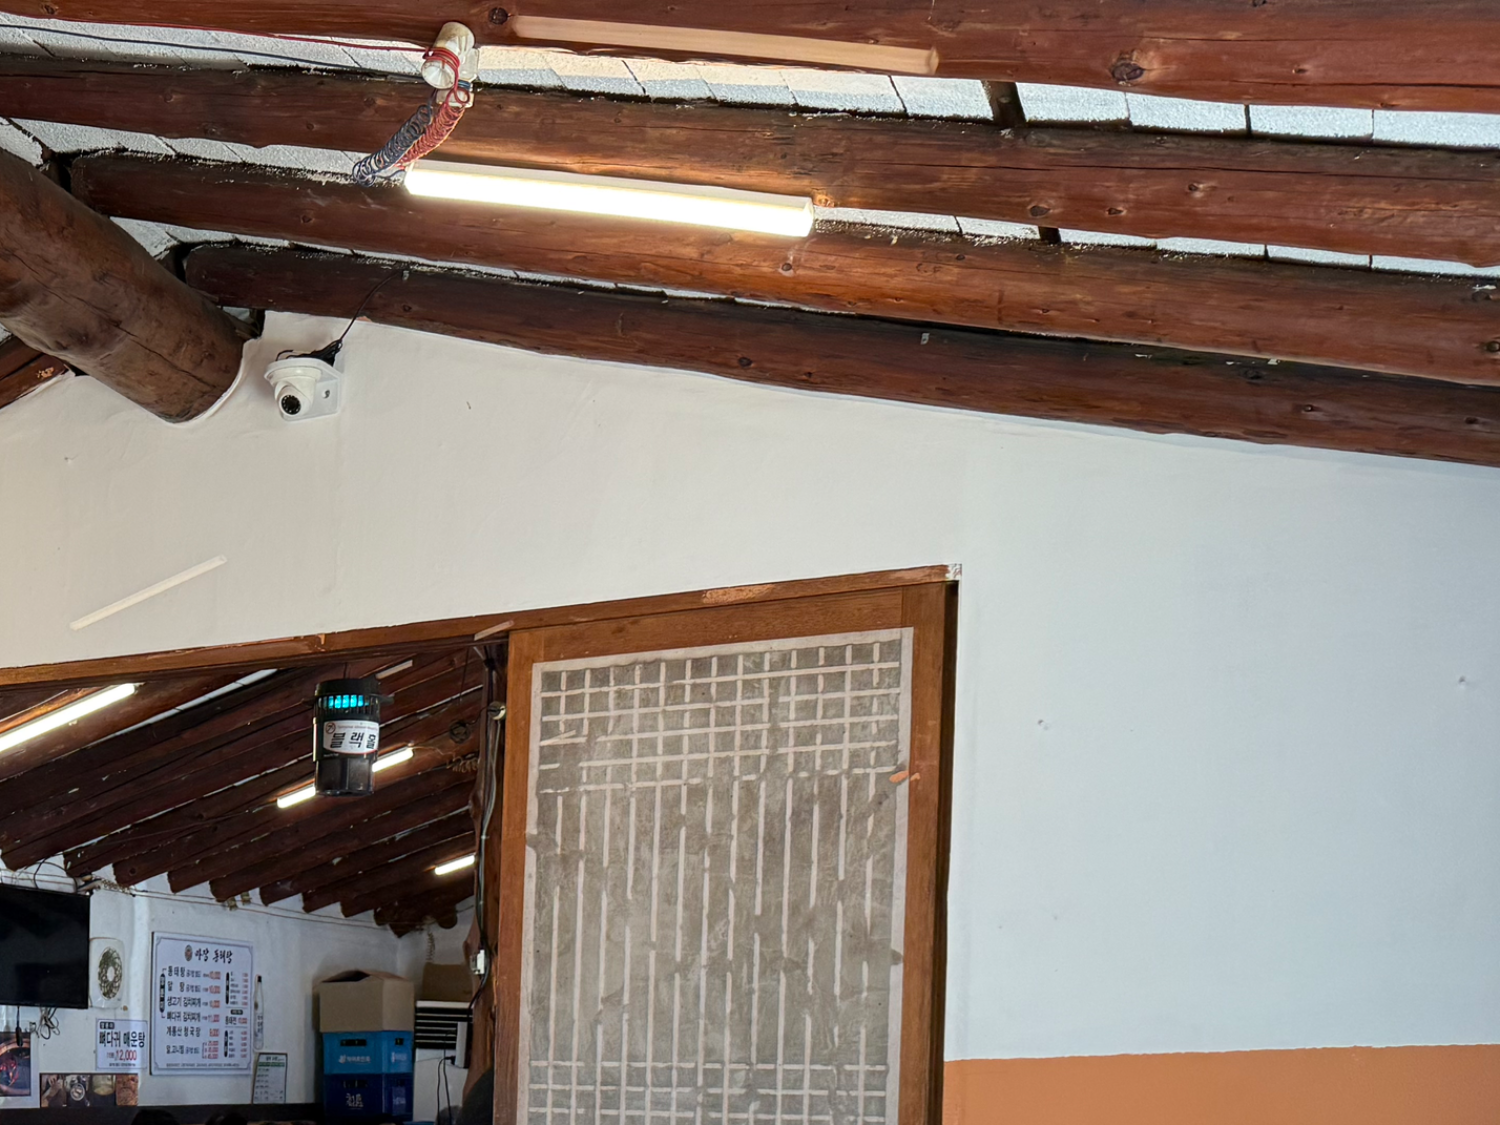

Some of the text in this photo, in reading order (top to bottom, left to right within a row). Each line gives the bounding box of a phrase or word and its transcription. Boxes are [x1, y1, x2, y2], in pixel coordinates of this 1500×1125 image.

[330, 732, 376, 749] 블랙홀
[99, 1031, 145, 1048] 뼈다귀 매운탕
